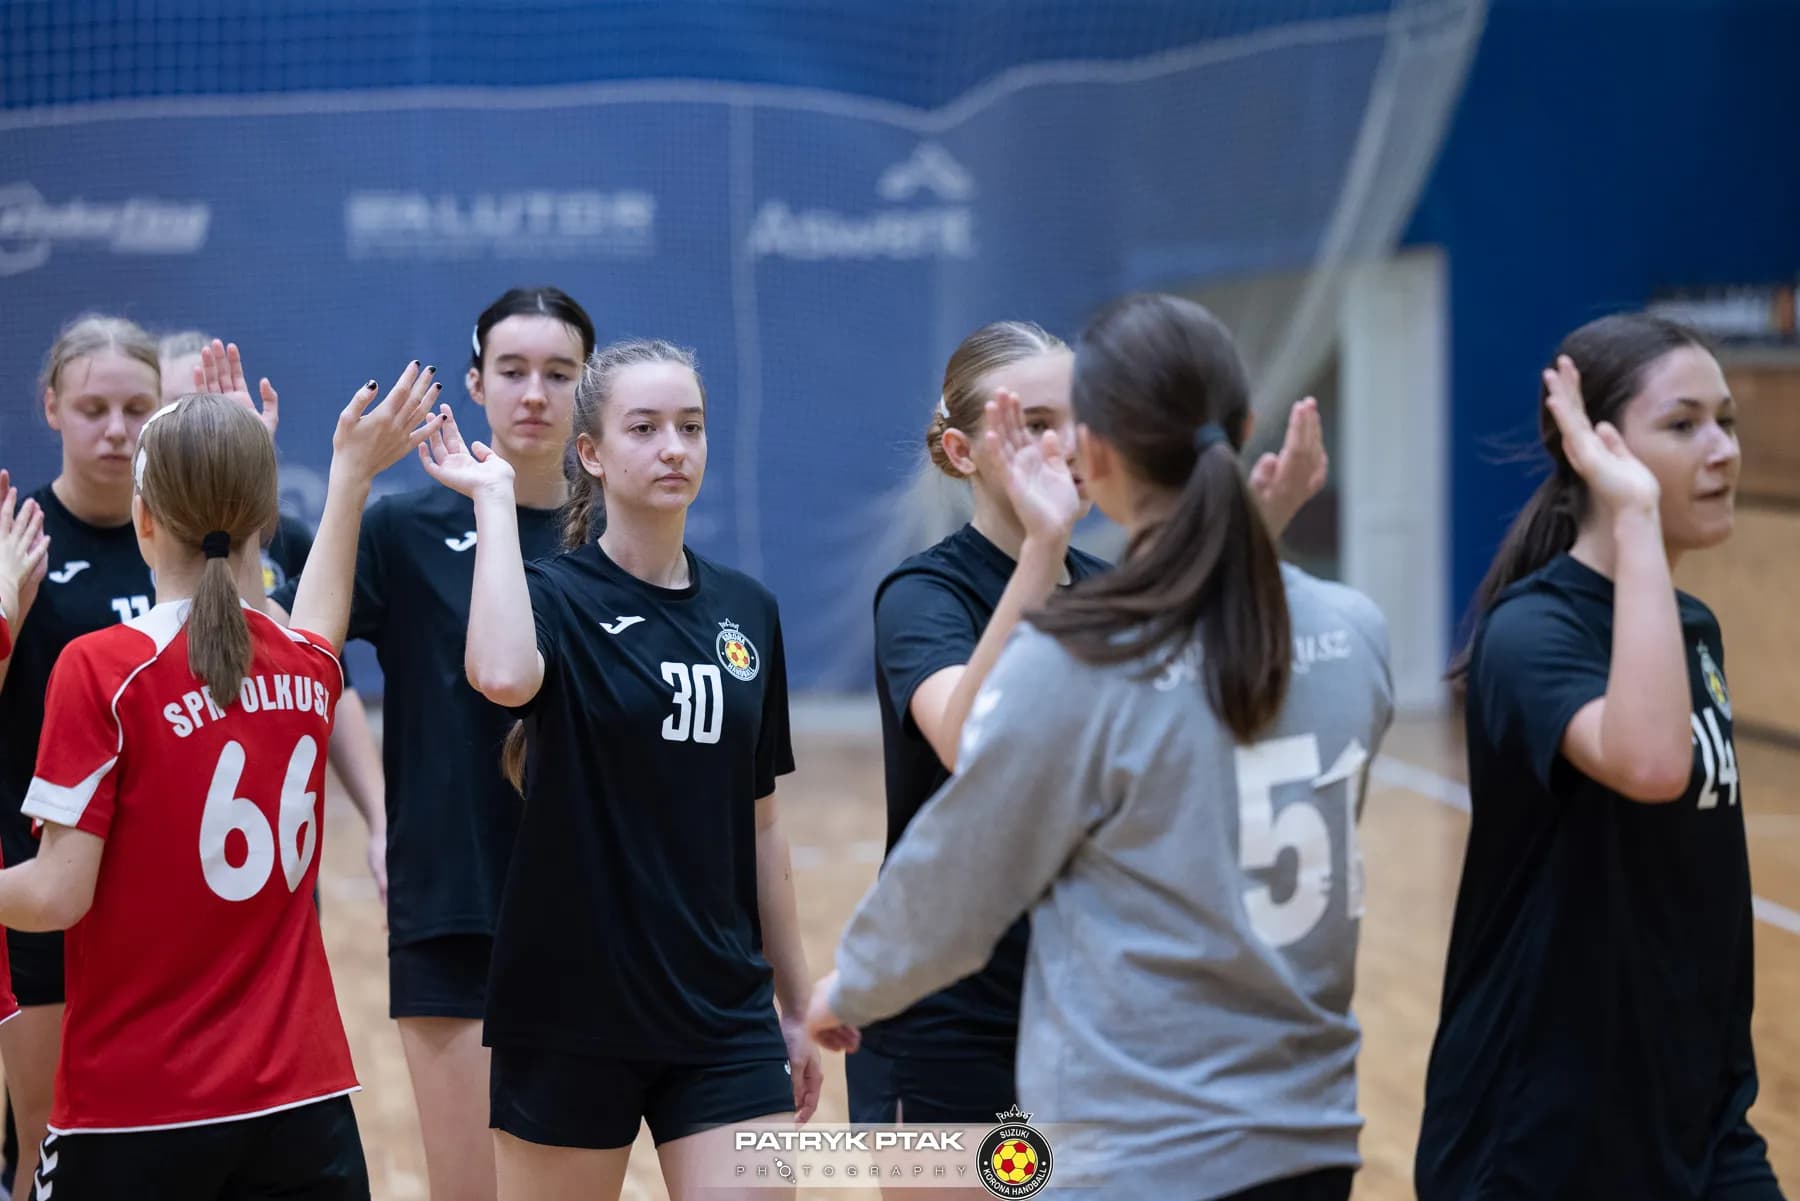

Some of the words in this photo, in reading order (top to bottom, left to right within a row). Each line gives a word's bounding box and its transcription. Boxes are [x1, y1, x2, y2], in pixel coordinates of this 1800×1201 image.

[661, 661, 724, 744] 30
[1691, 707, 1738, 809] 24
[198, 734, 318, 902] 66
[1233, 733, 1368, 949] 51
